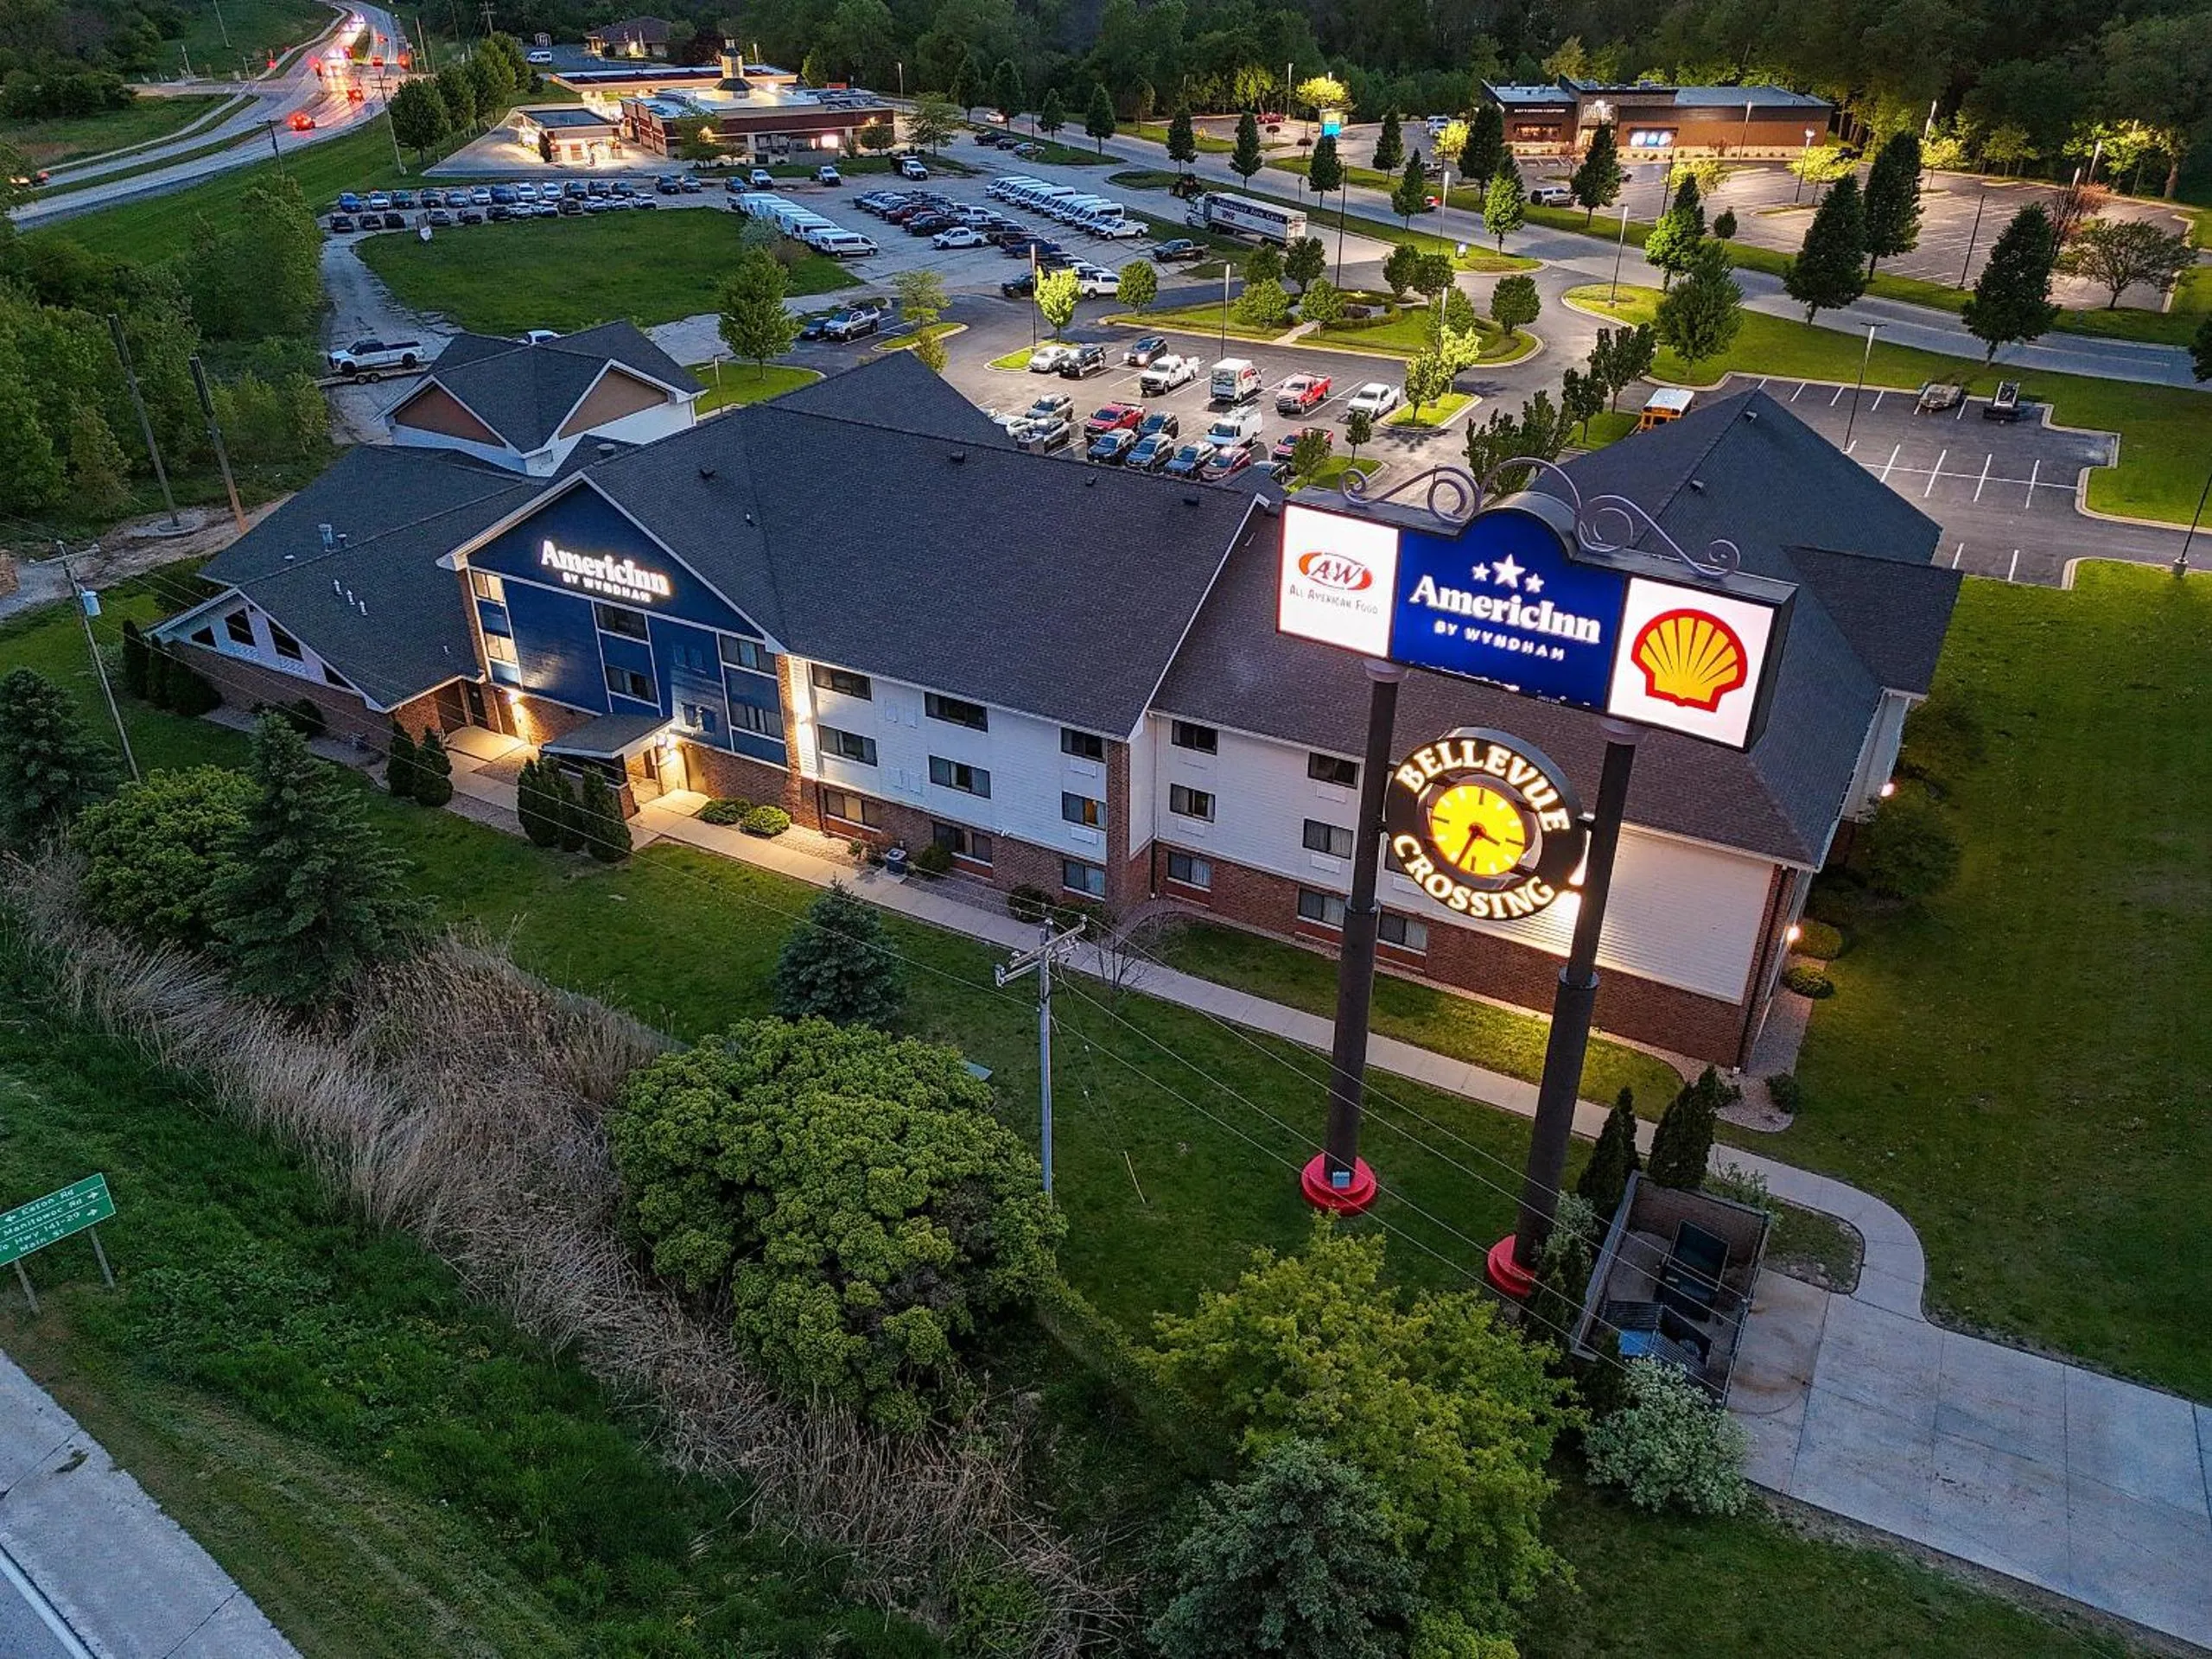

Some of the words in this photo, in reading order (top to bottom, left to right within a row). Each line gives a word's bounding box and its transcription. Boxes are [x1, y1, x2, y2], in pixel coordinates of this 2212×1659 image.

[541, 539, 672, 596] AmericInn
[563, 571, 579, 584] BY
[582, 576, 653, 603] WYNDHAM
[1408, 574, 1601, 645] AmericInn
[1433, 620, 1459, 636] BY
[1464, 626, 1566, 662] WYNDHAM
[1395, 740, 1571, 833] BELLEVUE
[1393, 834, 1555, 919] CROSSING
[60, 1189, 74, 1198] Rd
[3, 1207, 63, 1236] Manitowoc
[68, 1198, 83, 1209] Rd
[19, 1237, 48, 1252] Main
